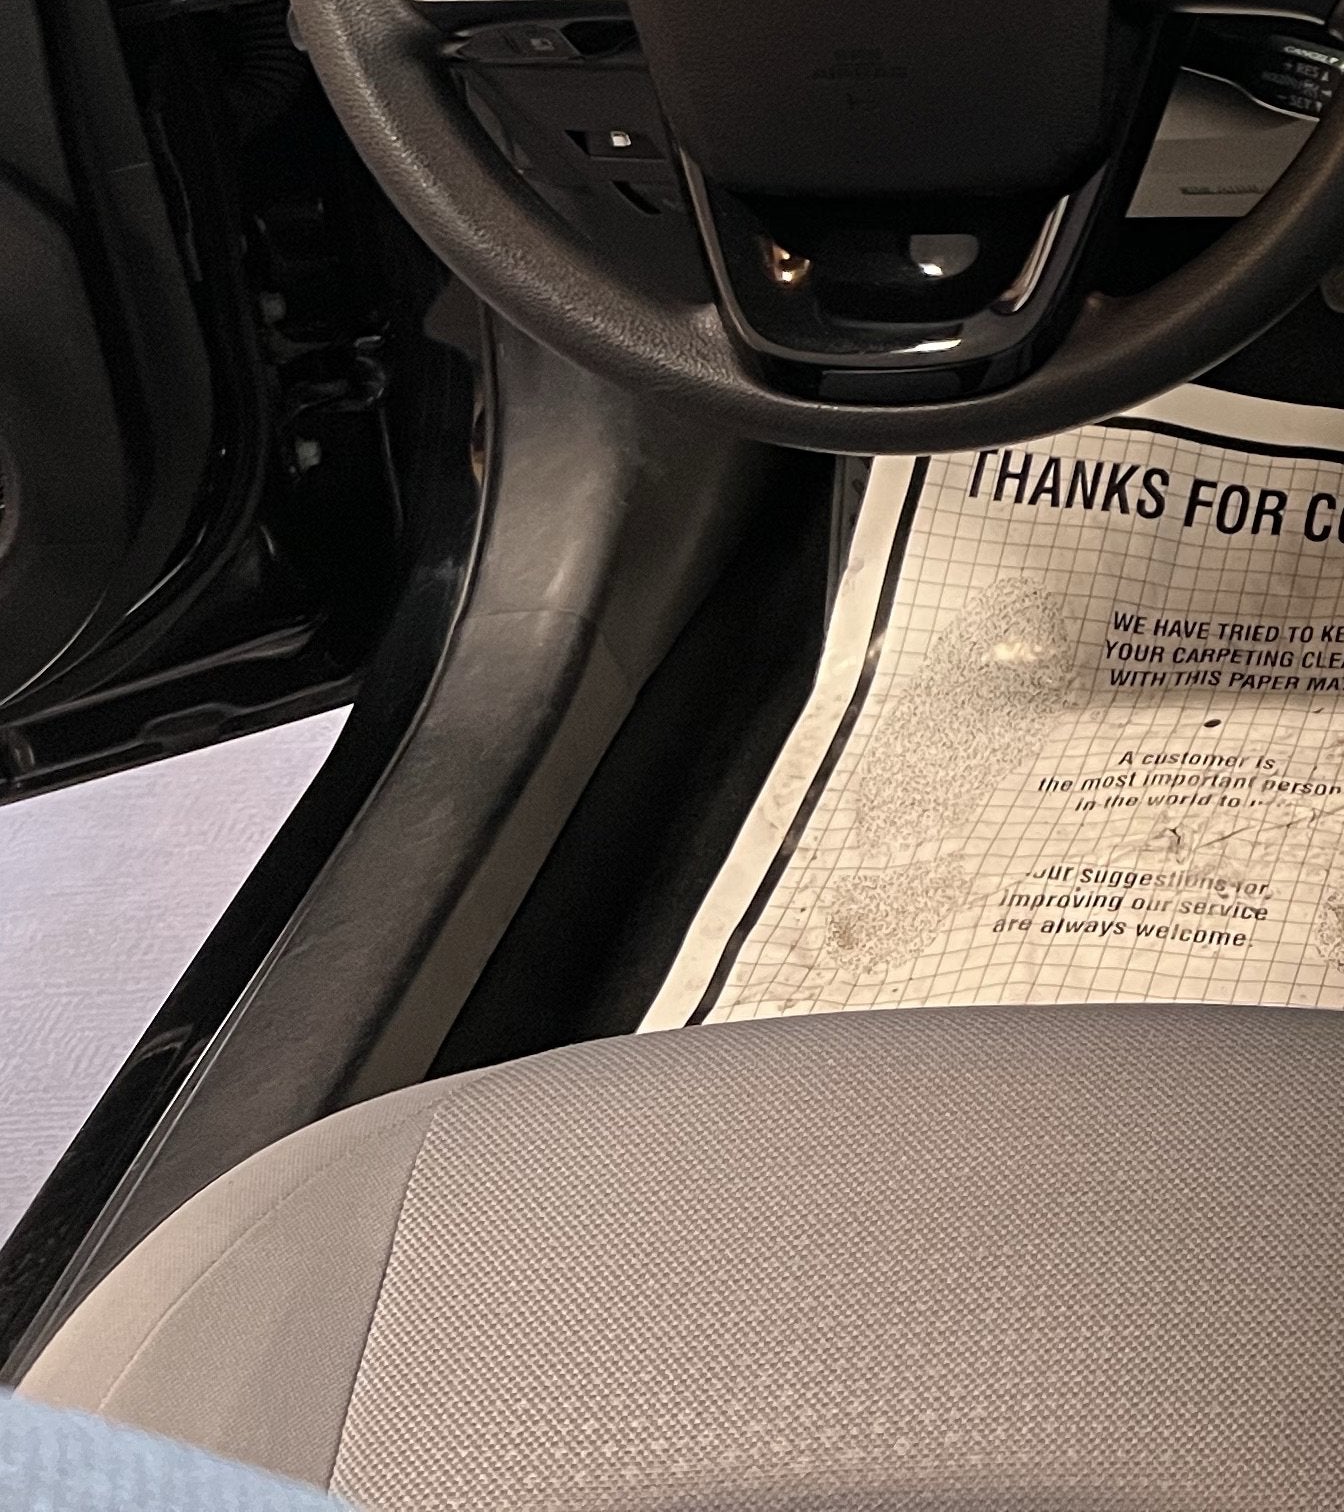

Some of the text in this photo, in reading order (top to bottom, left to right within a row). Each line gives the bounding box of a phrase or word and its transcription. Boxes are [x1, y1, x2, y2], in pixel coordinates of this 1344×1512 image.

[969, 449, 1169, 520] THANKS
[1183, 477, 1288, 537] FOR
[1113, 611, 1148, 635] WE
[1153, 619, 1211, 640] HAVE
[1218, 622, 1280, 643] TRIED
[1288, 626, 1314, 644] TO
[1105, 639, 1164, 664] YOUR
[1172, 646, 1294, 668] CARPETING
[1109, 669, 1166, 687] WITH
[1175, 670, 1222, 687] THIS
[1228, 672, 1300, 691] PAPER
[1118, 750, 1276, 770] A customer is
[1037, 771, 1342, 797] the most important person
[1074, 797, 1096, 812] in
[1104, 794, 1138, 809] the
[1148, 792, 1213, 808] world
[1219, 794, 1241, 809] to
[999, 888, 1268, 922] improving our service
[993, 916, 1032, 934] are
[1040, 916, 1127, 938] always
